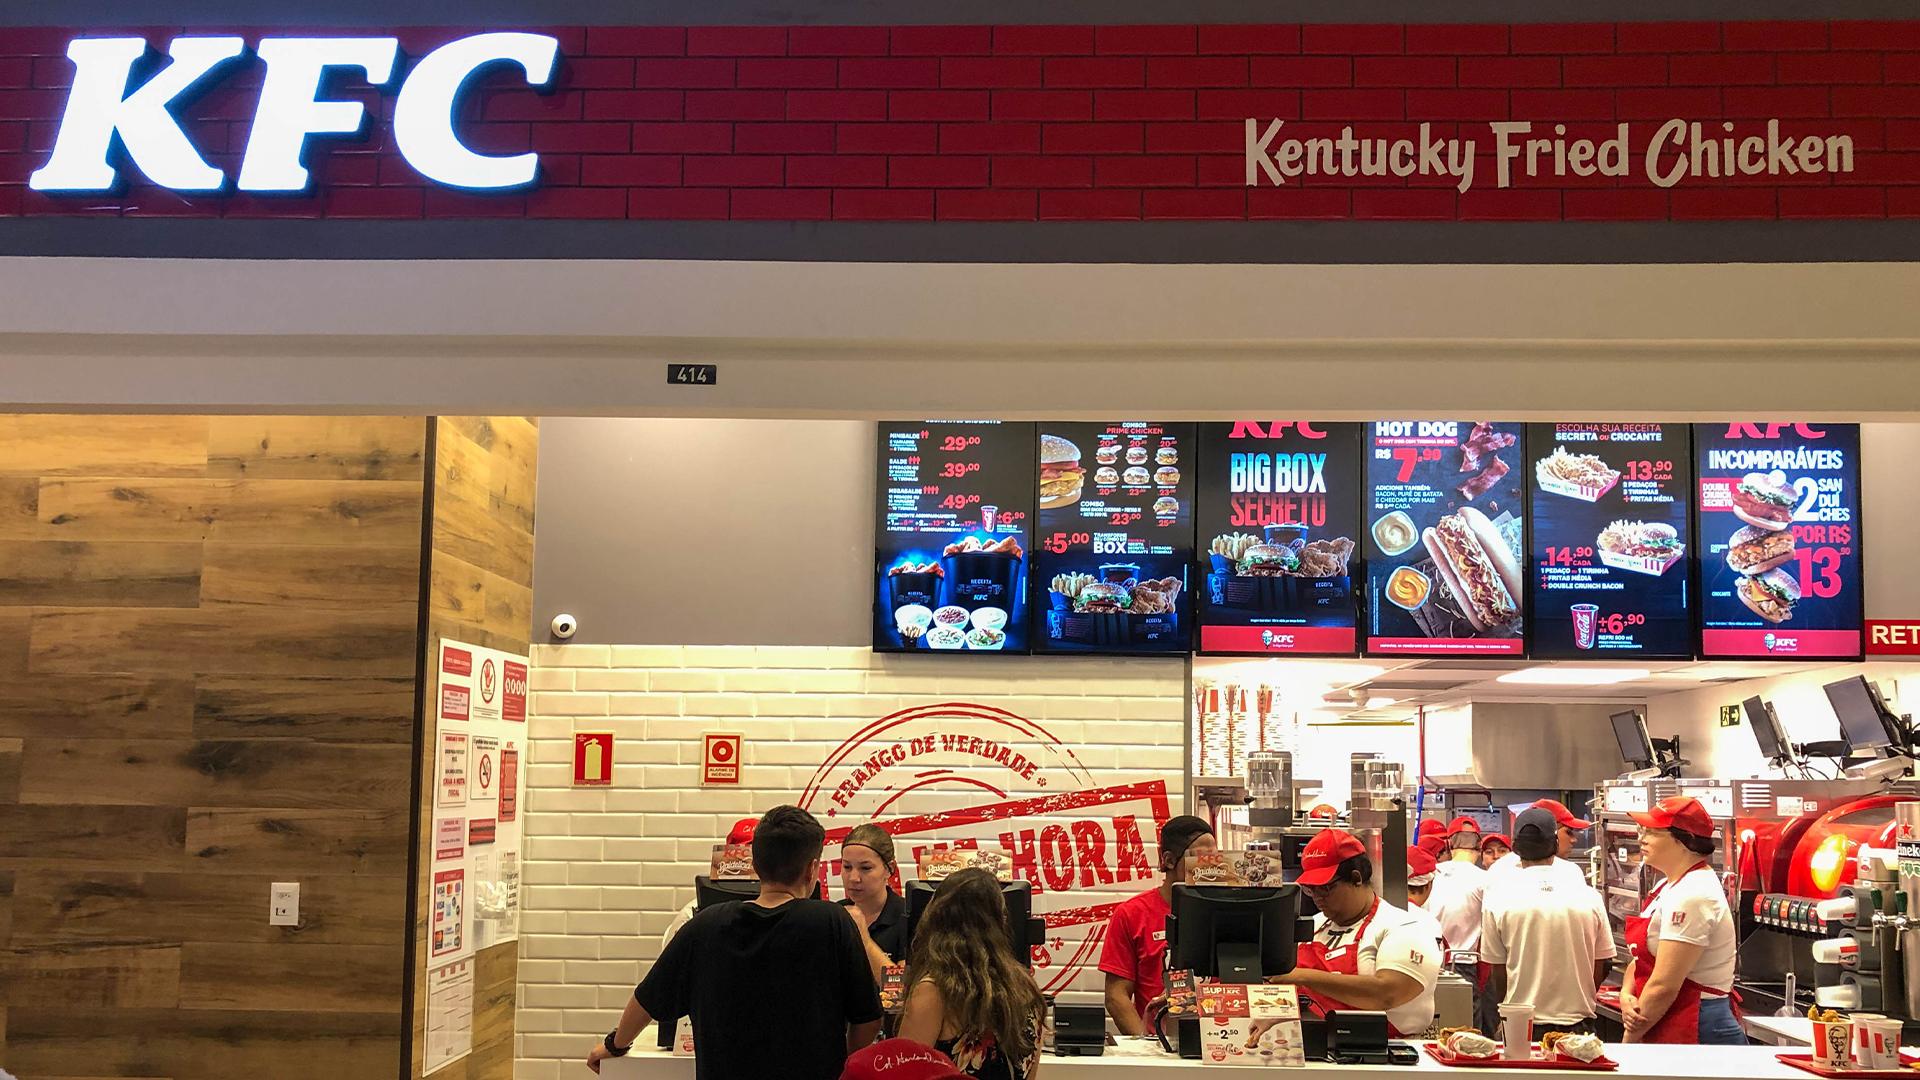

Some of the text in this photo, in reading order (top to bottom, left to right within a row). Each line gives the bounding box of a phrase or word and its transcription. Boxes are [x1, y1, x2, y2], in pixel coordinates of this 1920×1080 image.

[29, 32, 558, 191] KFC
[1245, 117, 1853, 193] Kentucky Fried Chicken
[677, 366, 707, 382] 414
[1375, 421, 1458, 437] HOT DOG
[1556, 424, 1662, 432] ESCOLHA SUA RECEITA
[1556, 433, 1598, 441] SECRETA
[1611, 433, 1662, 441] CROCANTE
[1375, 449, 1392, 460] R$
[1709, 446, 1843, 469] INCOMPARÁVEIS
[1231, 453, 1327, 493] BIG BOX
[1627, 460, 1673, 480] 13,90
[1629, 481, 1657, 489] PEDAÇOS
[1793, 477, 1819, 521] 2
[1231, 493, 1327, 526] SECRETO
[1819, 507, 1850, 521] CHES
[1792, 524, 1851, 544] POR R$
[1094, 542, 1127, 554] BOX
[1546, 546, 1593, 566] 14,90
[1273, 635, 1295, 643] KFC
[1872, 625, 1920, 645] RET
[831, 734, 1038, 807] FRANGO DE VERDADE
[931, 853, 957, 861] KFC
[999, 814, 1154, 897] HORA
